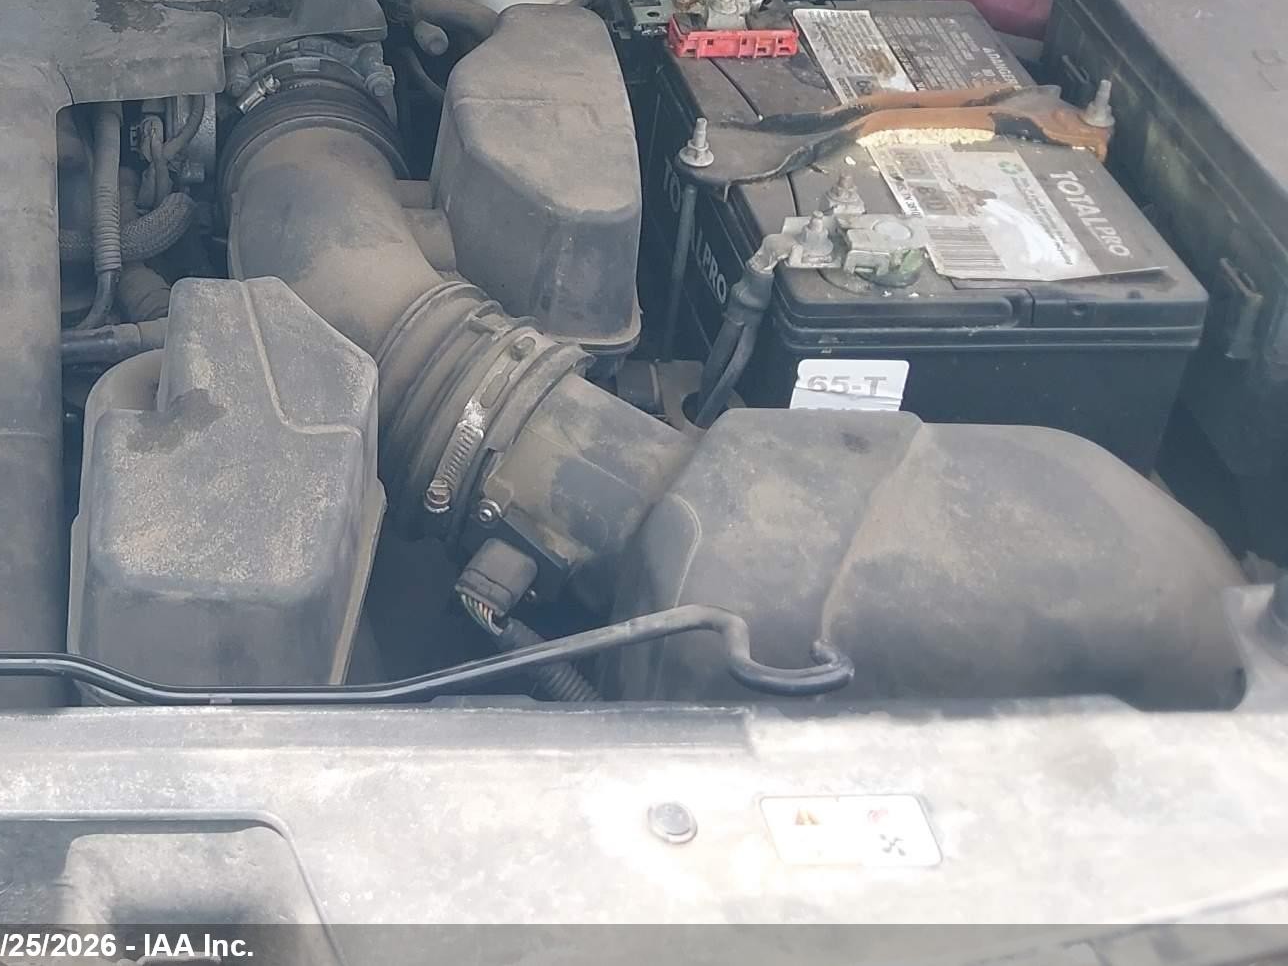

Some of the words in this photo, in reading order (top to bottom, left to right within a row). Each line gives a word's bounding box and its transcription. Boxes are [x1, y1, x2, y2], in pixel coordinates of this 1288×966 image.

[663, 155, 727, 305] TOLPRO
[1049, 168, 1132, 259] TOTALPRO
[807, 374, 888, 396] 65-T
